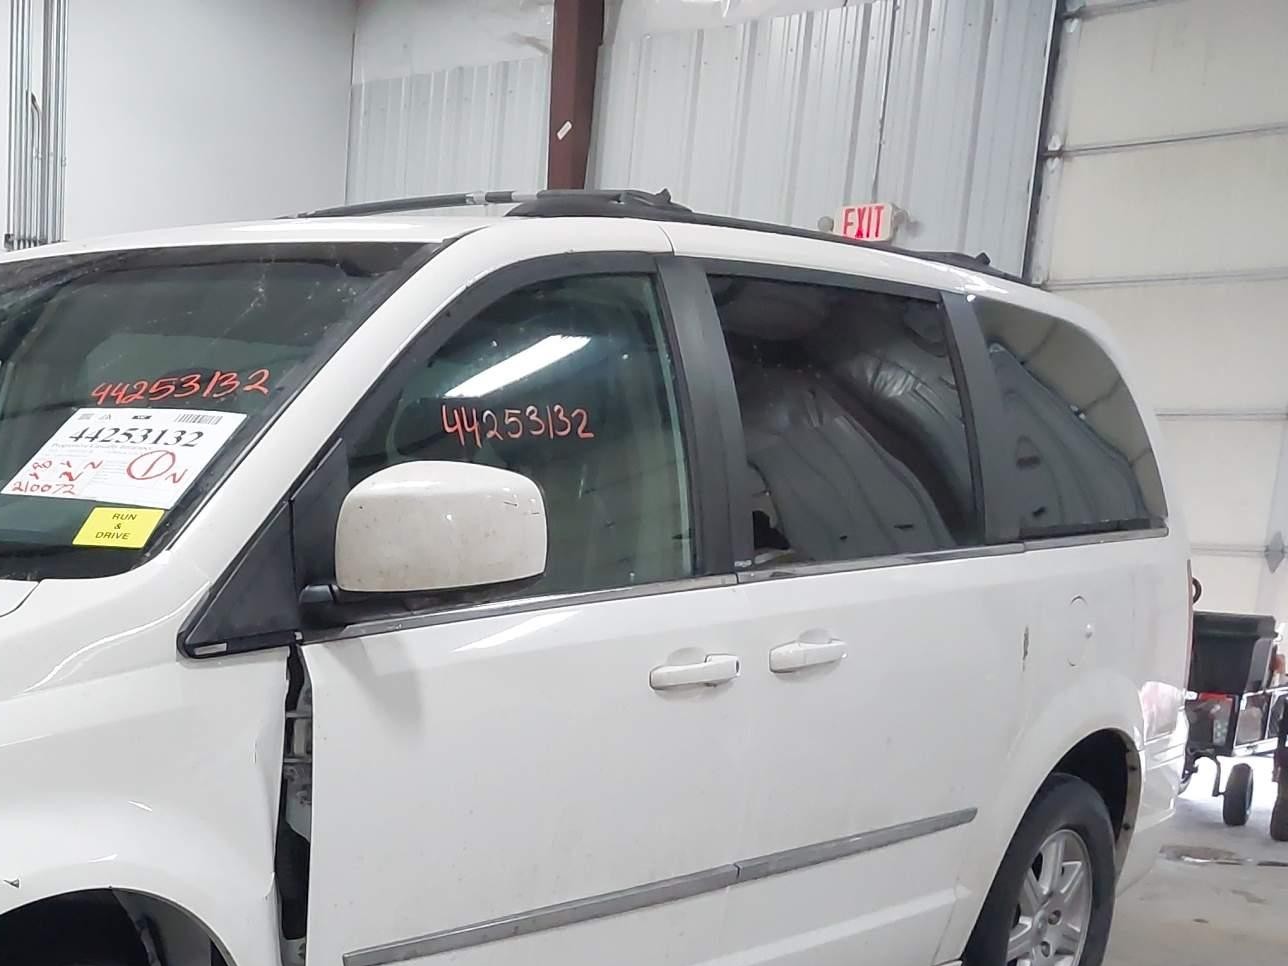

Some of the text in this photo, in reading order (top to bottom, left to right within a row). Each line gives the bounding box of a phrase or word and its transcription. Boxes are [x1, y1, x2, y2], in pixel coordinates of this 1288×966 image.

[843, 205, 885, 238] EXIT
[91, 369, 271, 405] 44253132
[69, 427, 204, 448] 44253132
[442, 404, 594, 448] 44253132
[112, 513, 137, 521] RUN
[95, 531, 130, 540] DRIVE
